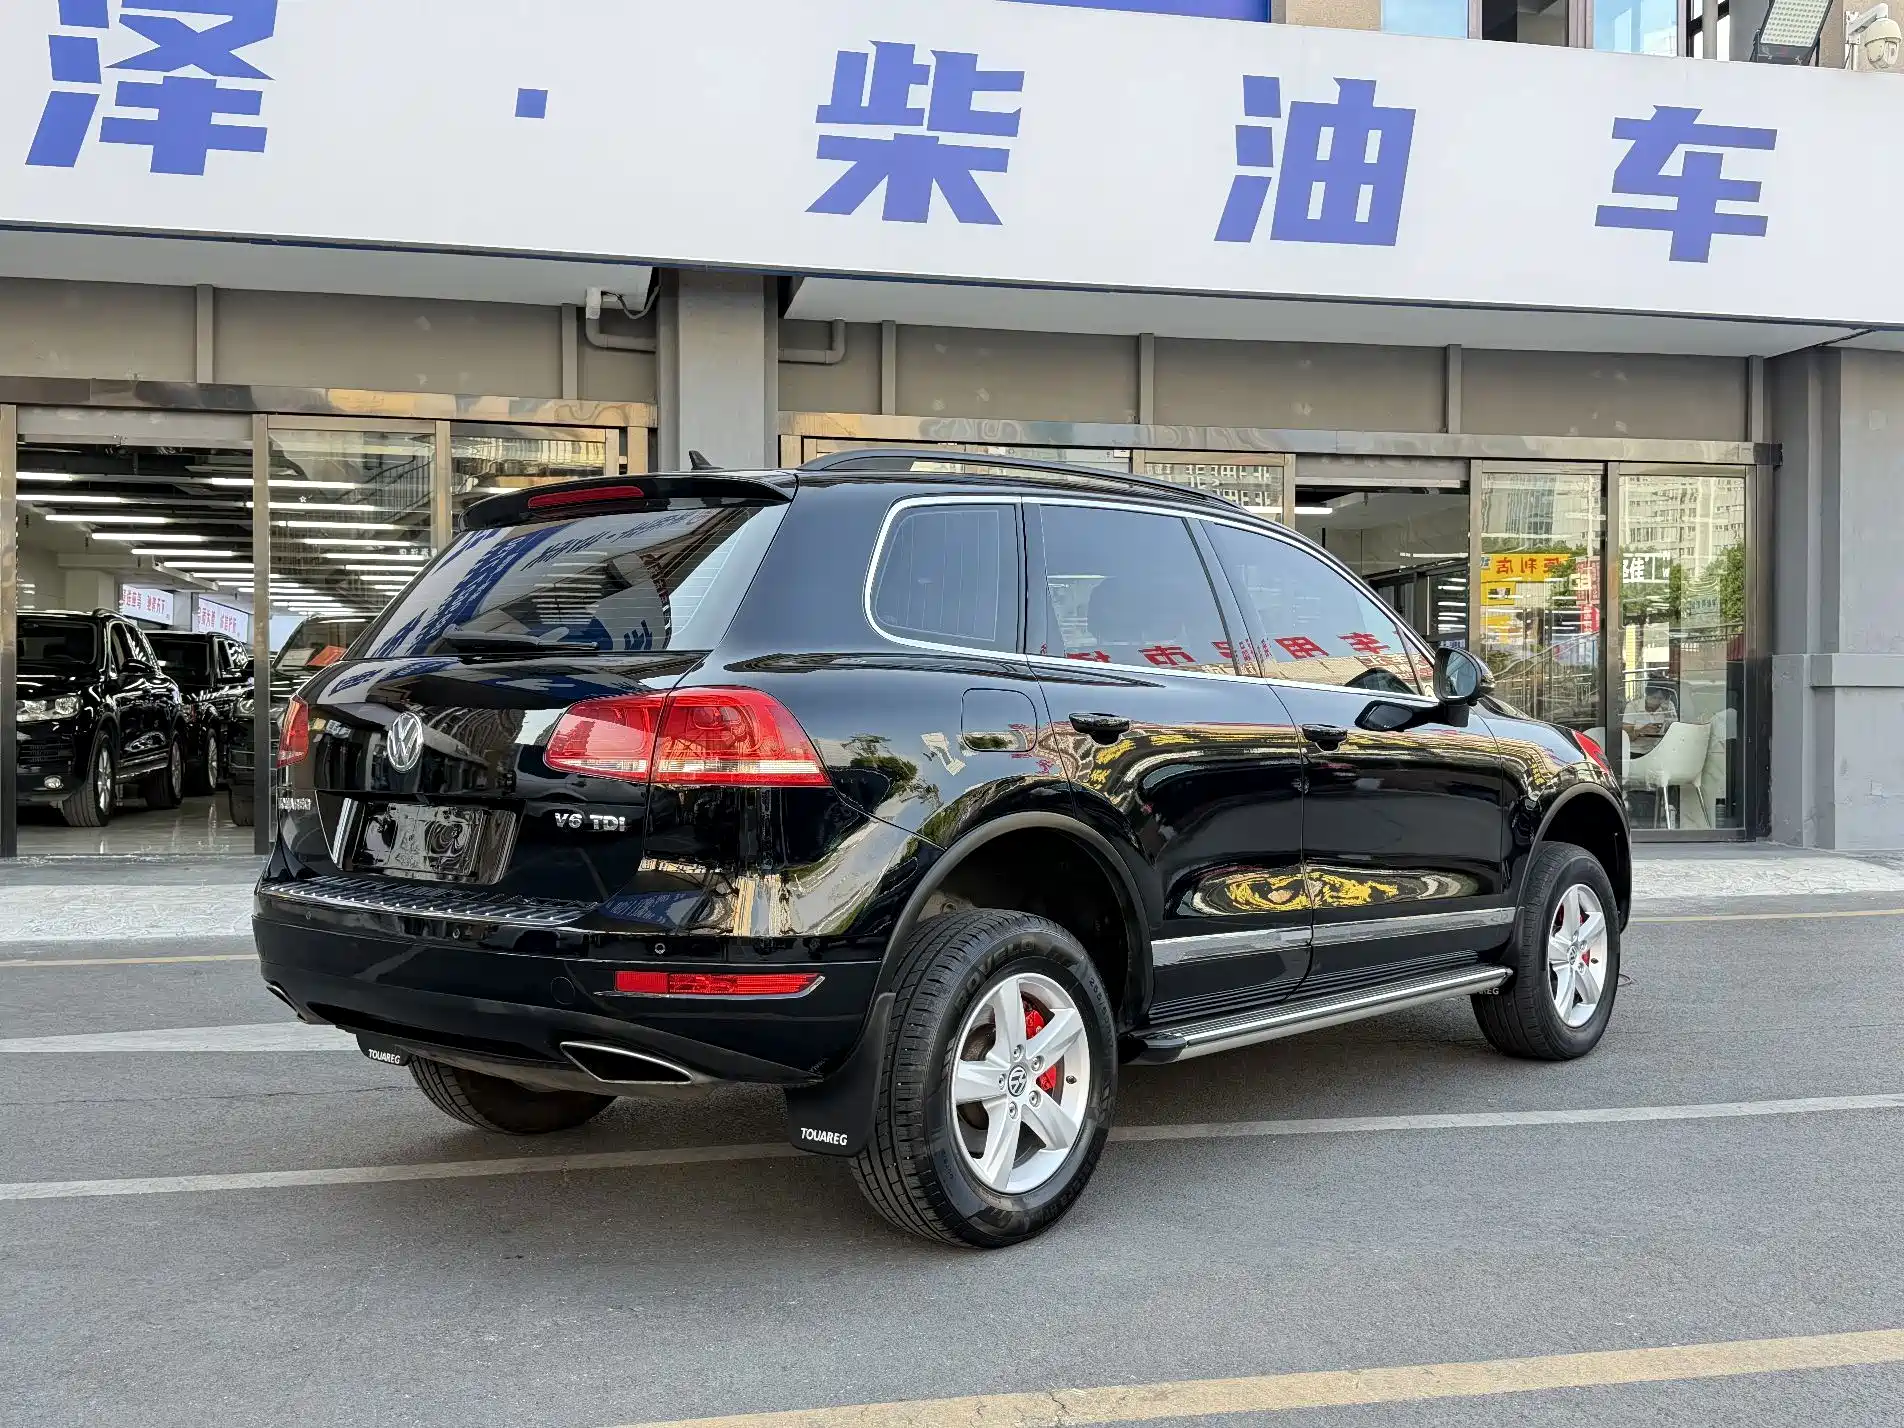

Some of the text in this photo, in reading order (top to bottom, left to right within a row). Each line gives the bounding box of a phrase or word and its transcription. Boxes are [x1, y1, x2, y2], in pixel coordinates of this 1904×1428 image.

[554, 812, 626, 832] V6 TDI
[368, 1048, 401, 1065] TOUAREG
[800, 1127, 848, 1146] TOUAREG
